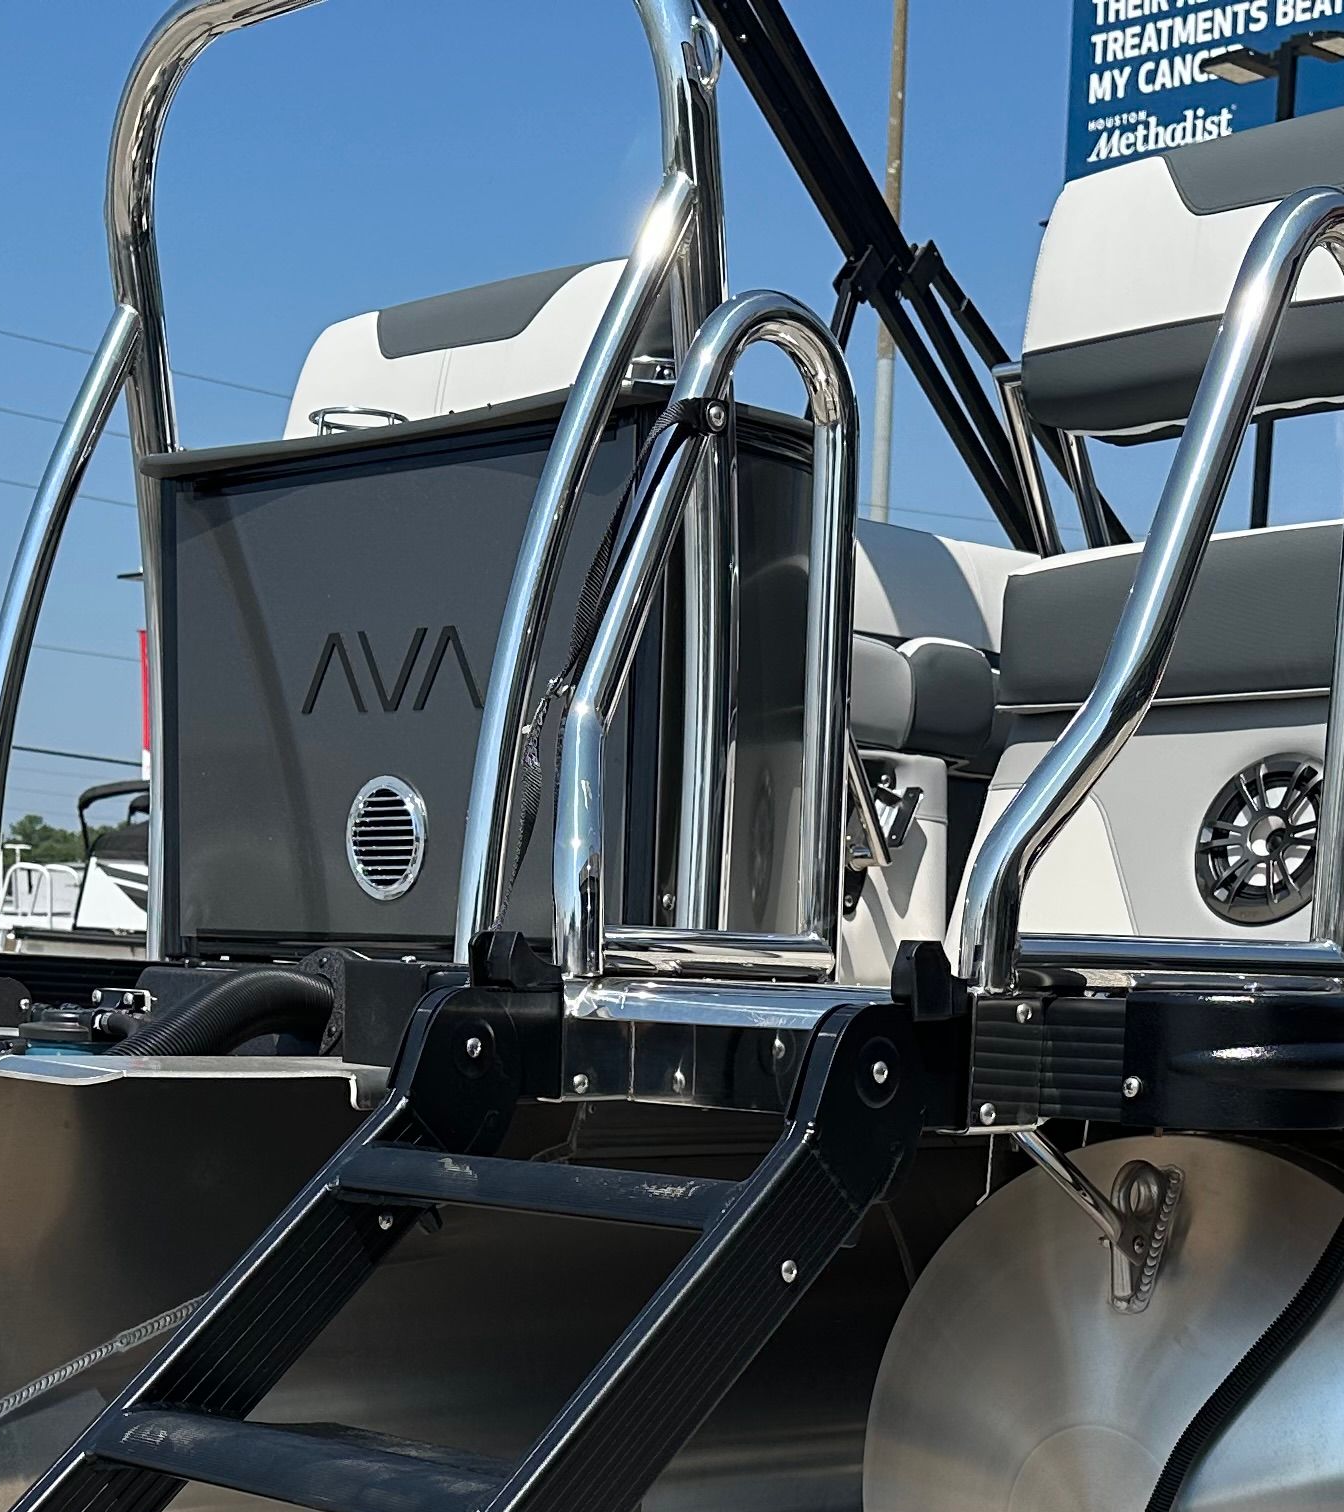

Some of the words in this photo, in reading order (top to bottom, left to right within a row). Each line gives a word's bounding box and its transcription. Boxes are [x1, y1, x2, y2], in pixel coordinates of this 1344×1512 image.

[1091, 2, 1268, 64] TREATMENTS
[1088, 66, 1132, 104] MY
[1137, 43, 1244, 94] CANC
[1086, 107, 1233, 162] Methodist
[1088, 110, 1147, 131] HOUSTON
